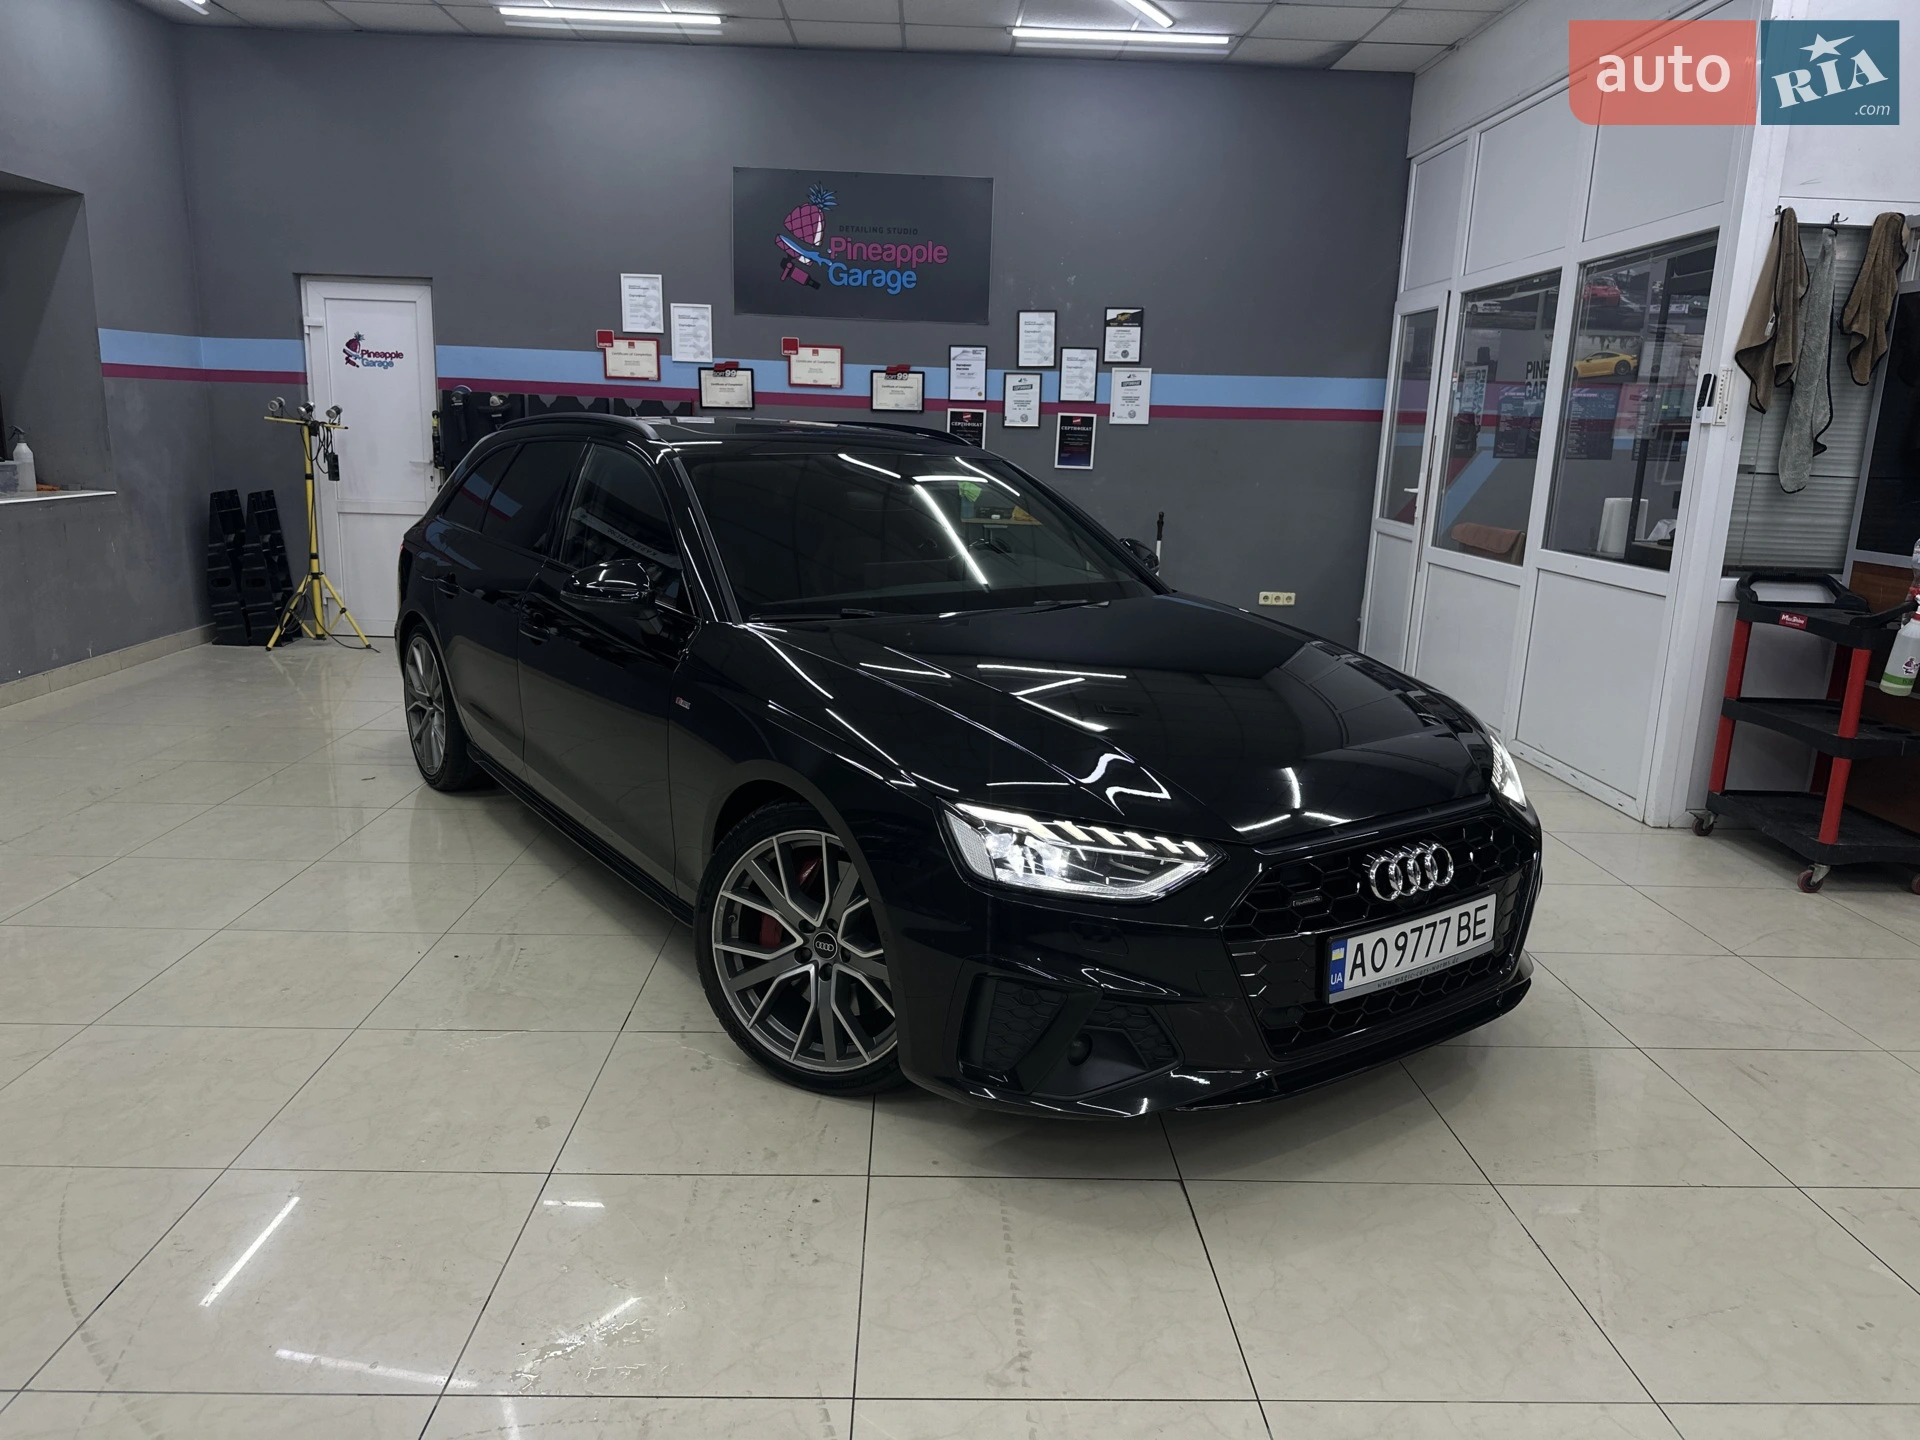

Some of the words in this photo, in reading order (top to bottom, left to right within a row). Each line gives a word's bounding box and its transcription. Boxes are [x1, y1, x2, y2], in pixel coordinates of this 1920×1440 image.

[838, 224, 884, 235] DETAILING
[887, 227, 919, 236] STUDIO
[830, 236, 949, 269] Pineapple
[828, 262, 917, 295] Garage
[361, 349, 404, 360] Pineapple
[361, 359, 395, 370] Garage
[724, 369, 737, 377] 99
[896, 372, 909, 380] 99
[1349, 937, 1388, 981] AO
[1394, 916, 1451, 968] 9777
[1456, 904, 1488, 947] BE
[1330, 971, 1343, 986] UA
